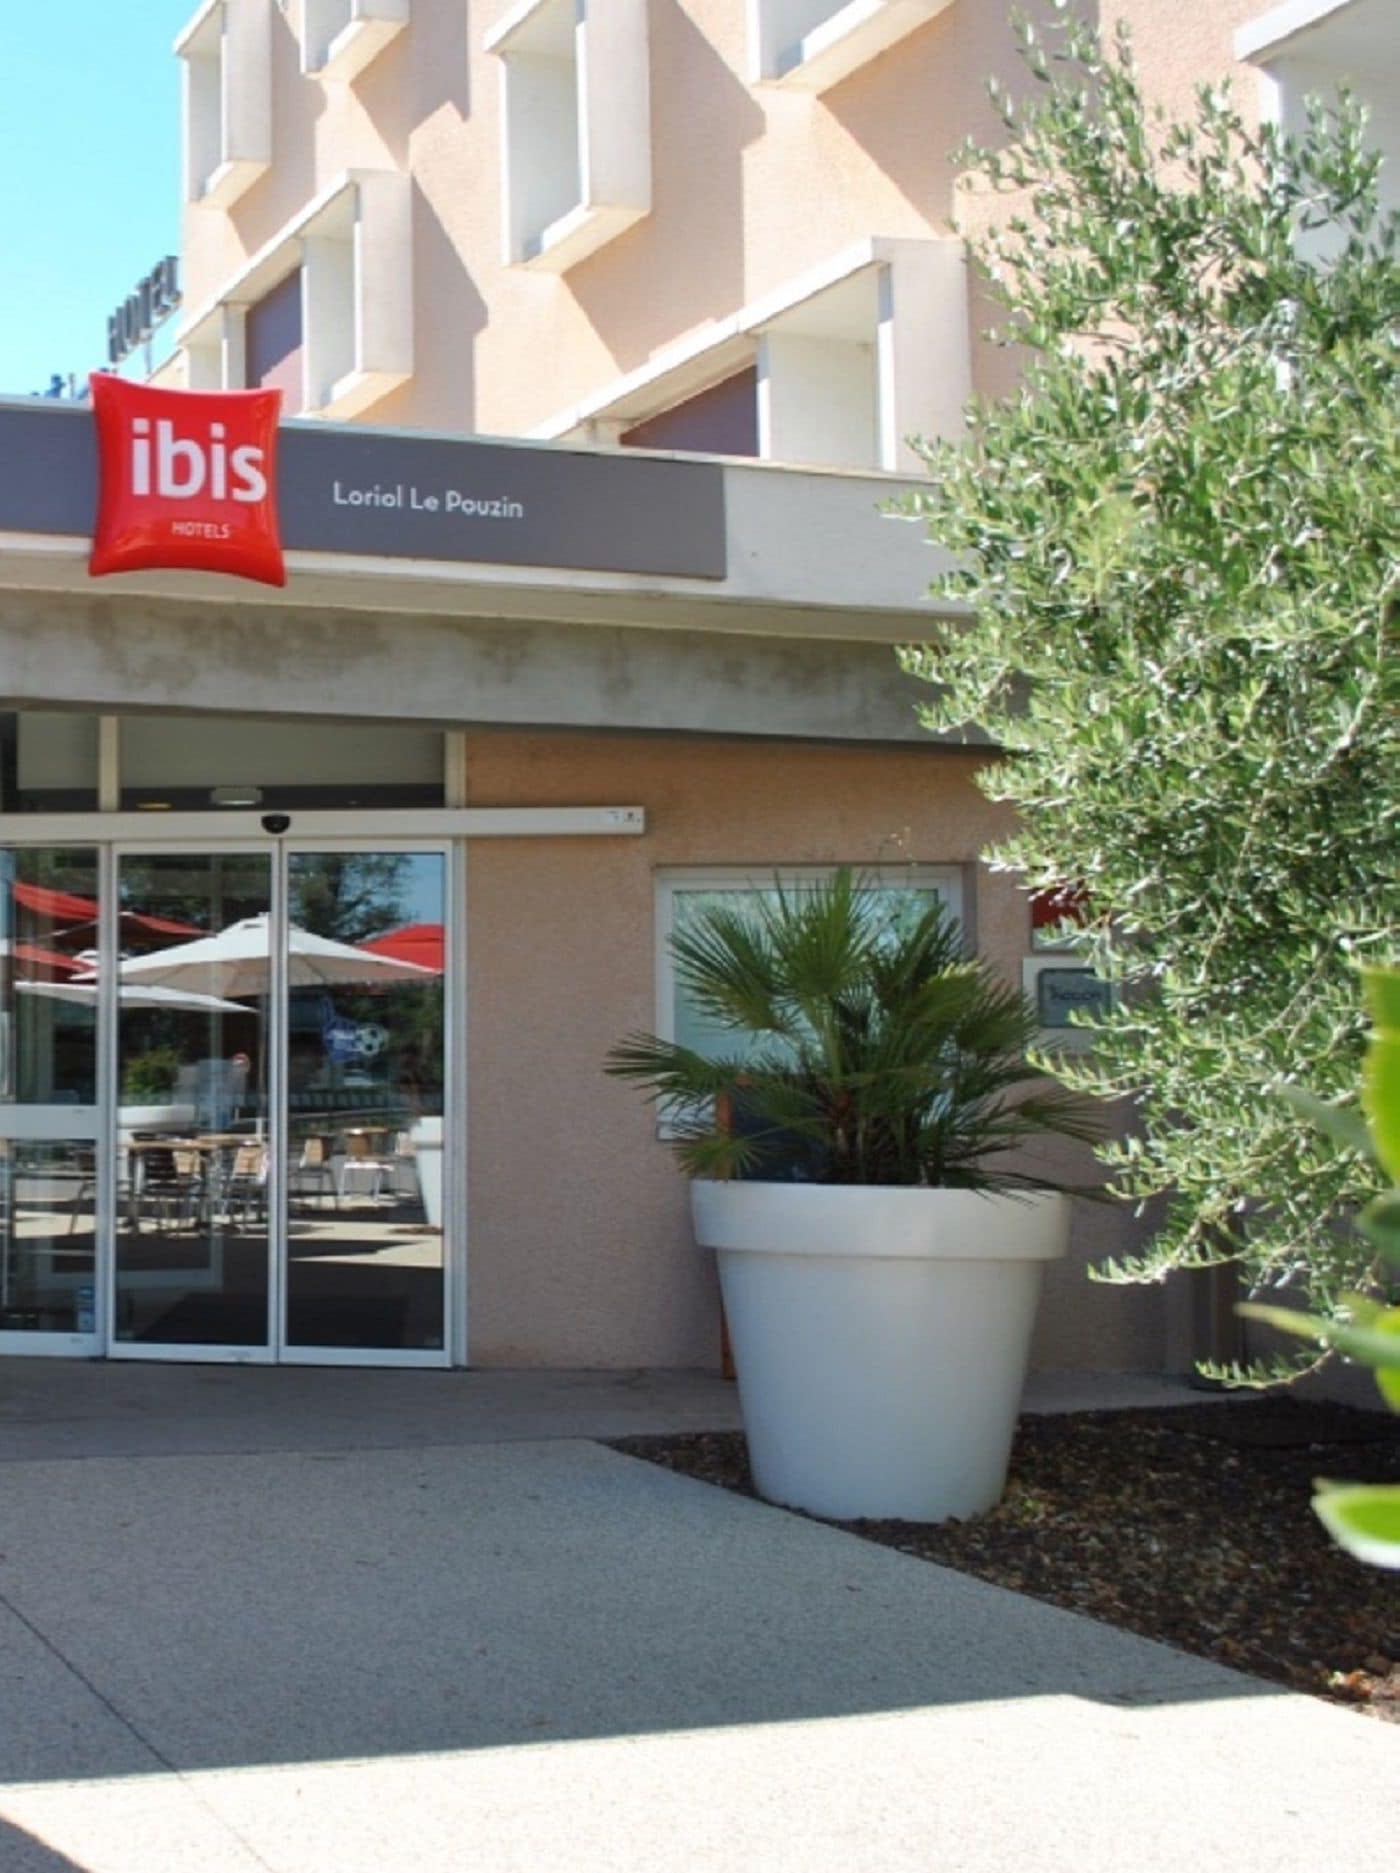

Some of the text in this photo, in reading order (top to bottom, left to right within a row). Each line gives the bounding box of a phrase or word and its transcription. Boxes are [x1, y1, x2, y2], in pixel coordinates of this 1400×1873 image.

[131, 418, 267, 503] ibis
[333, 480, 524, 518] Loriol Le Pouzin
[171, 521, 231, 539] HOTELS
